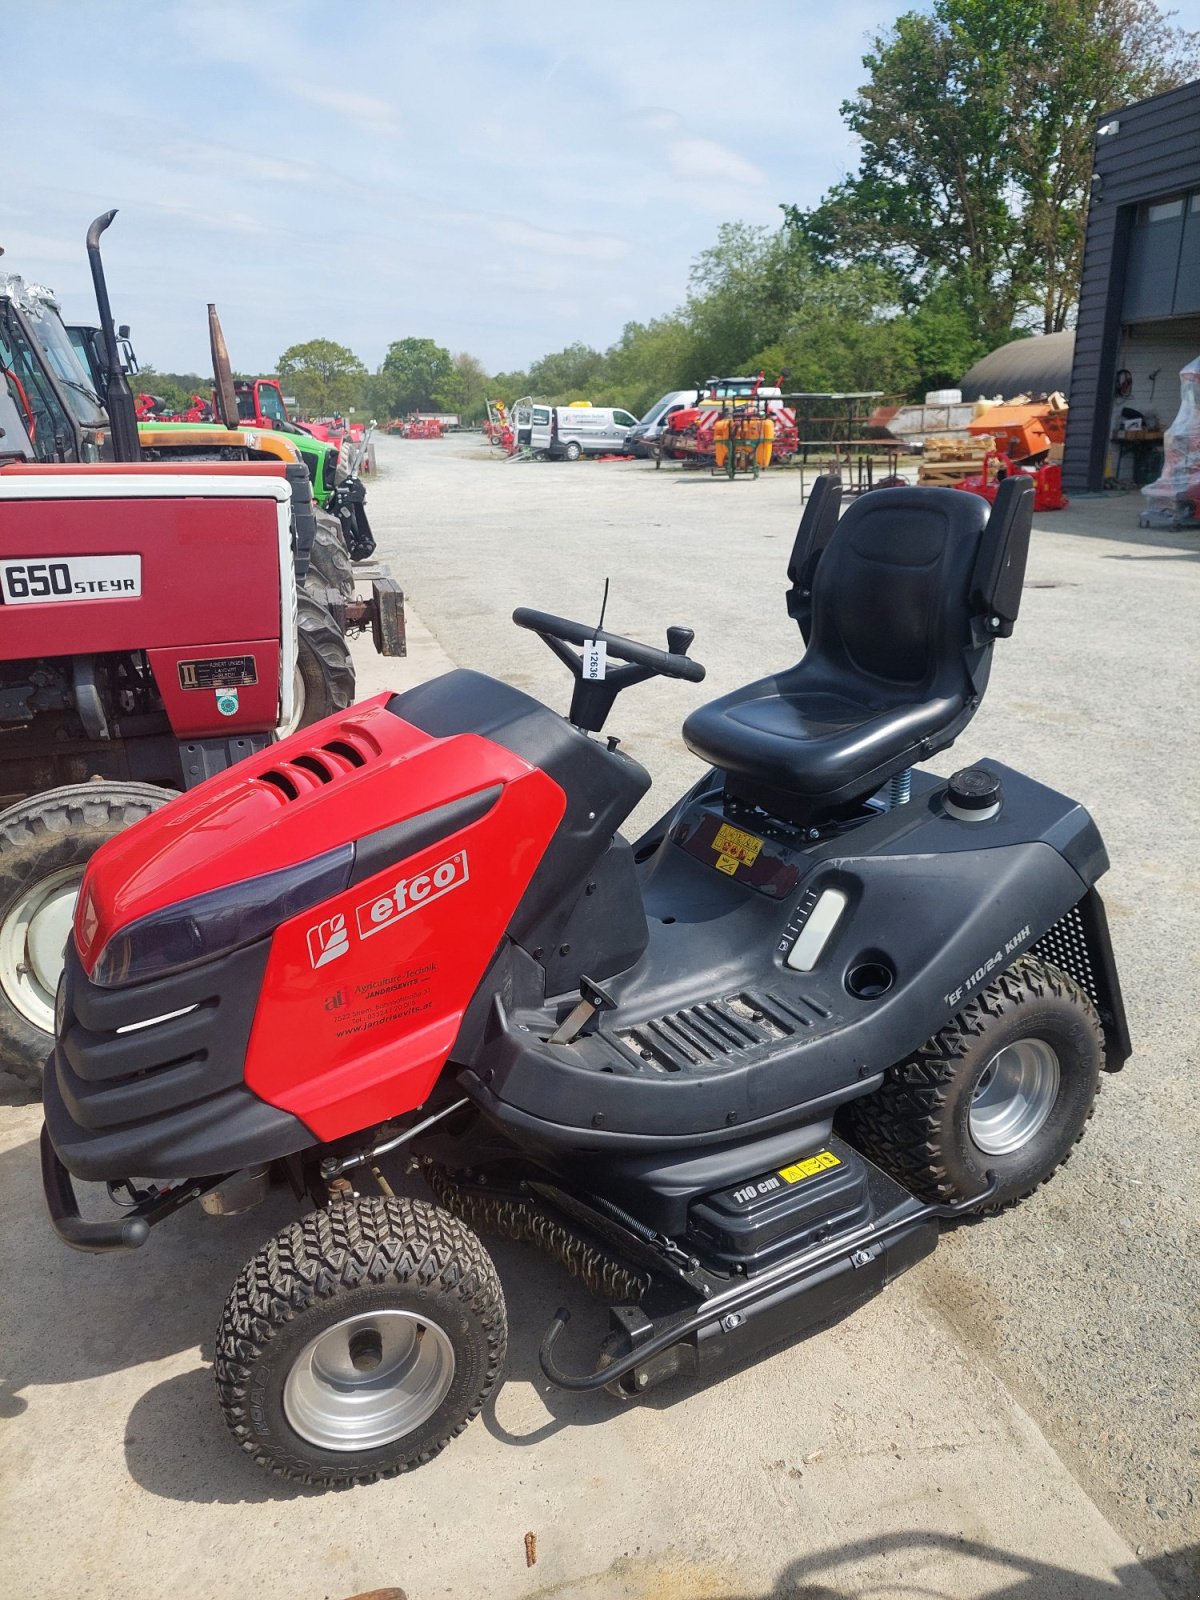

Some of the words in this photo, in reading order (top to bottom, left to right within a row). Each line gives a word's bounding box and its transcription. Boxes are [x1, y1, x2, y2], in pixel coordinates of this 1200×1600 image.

[5, 563, 73, 598] 650
[74, 579, 135, 594] STEYR
[589, 651, 599, 679] 12636
[370, 863, 456, 922] efco
[965, 950, 1003, 991] 110/24
[1004, 924, 1031, 955] KHH
[366, 978, 418, 1000] JANDRISEVITS
[733, 1185, 757, 1204] 110
[757, 1177, 781, 1194] cm
